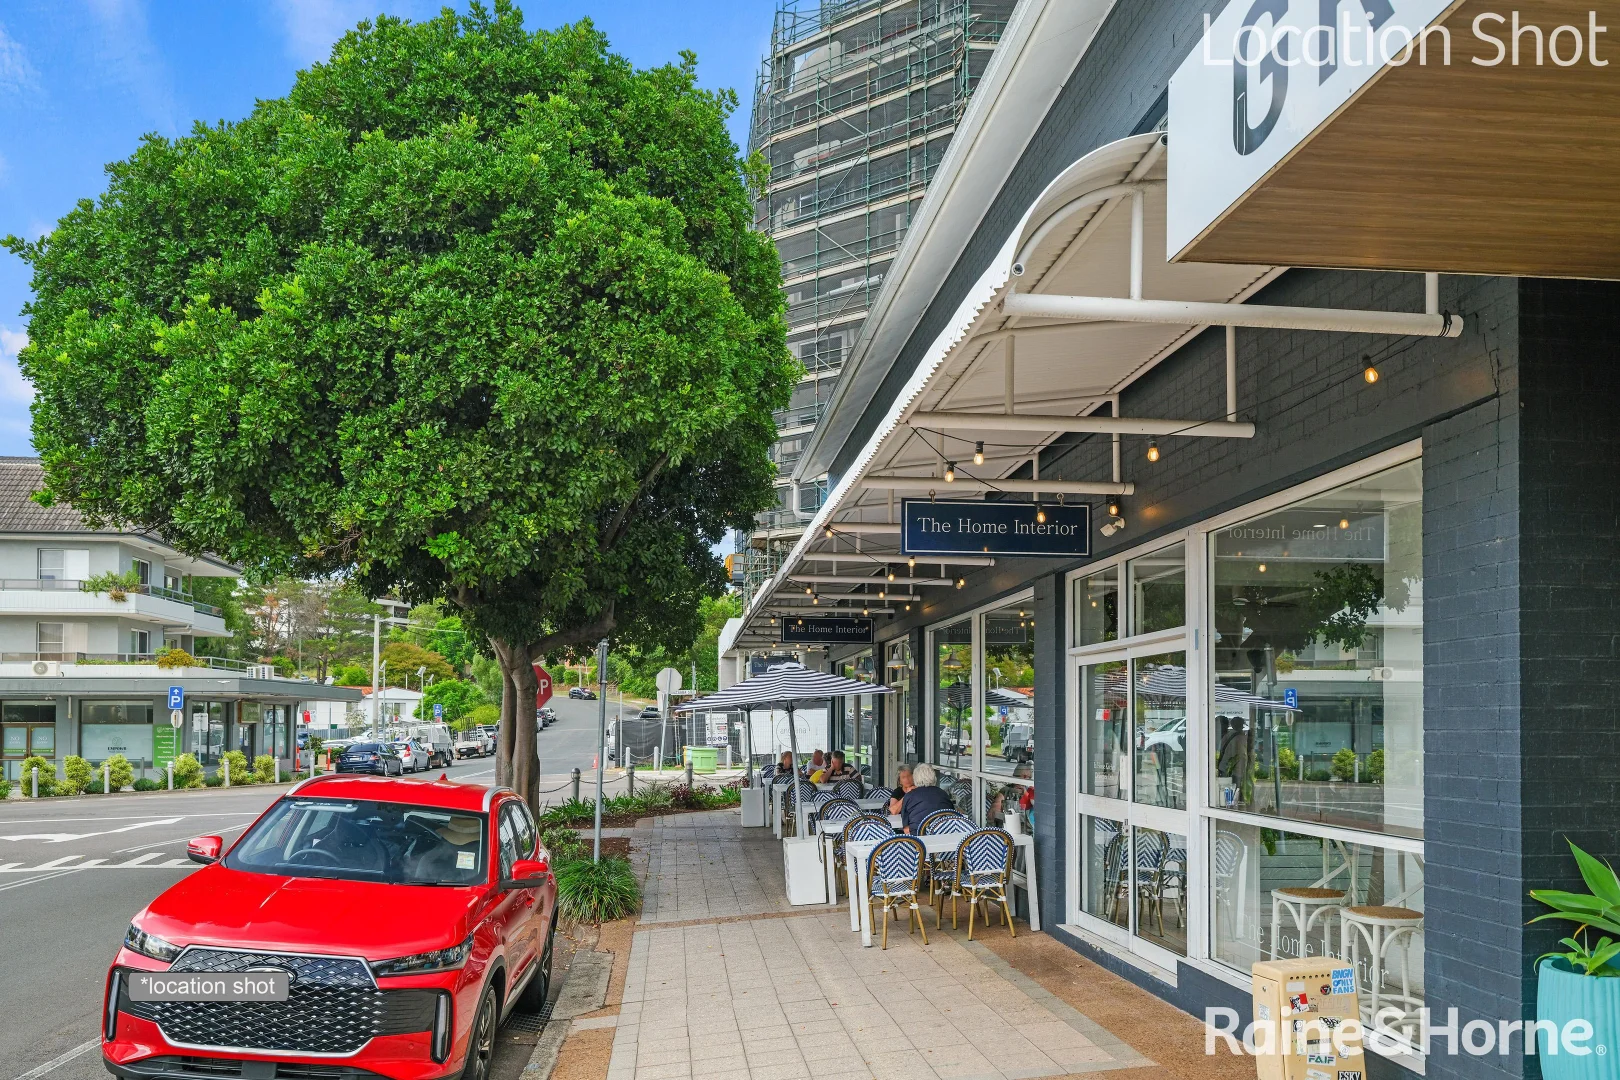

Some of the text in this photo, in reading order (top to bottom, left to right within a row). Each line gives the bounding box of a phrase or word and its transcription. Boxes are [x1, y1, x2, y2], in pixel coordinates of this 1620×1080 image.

[917, 517, 1078, 536] The Home Interior
[788, 624, 867, 634] The Home Interior
[171, 695, 181, 707] P
[1333, 986, 1354, 994] FANS
